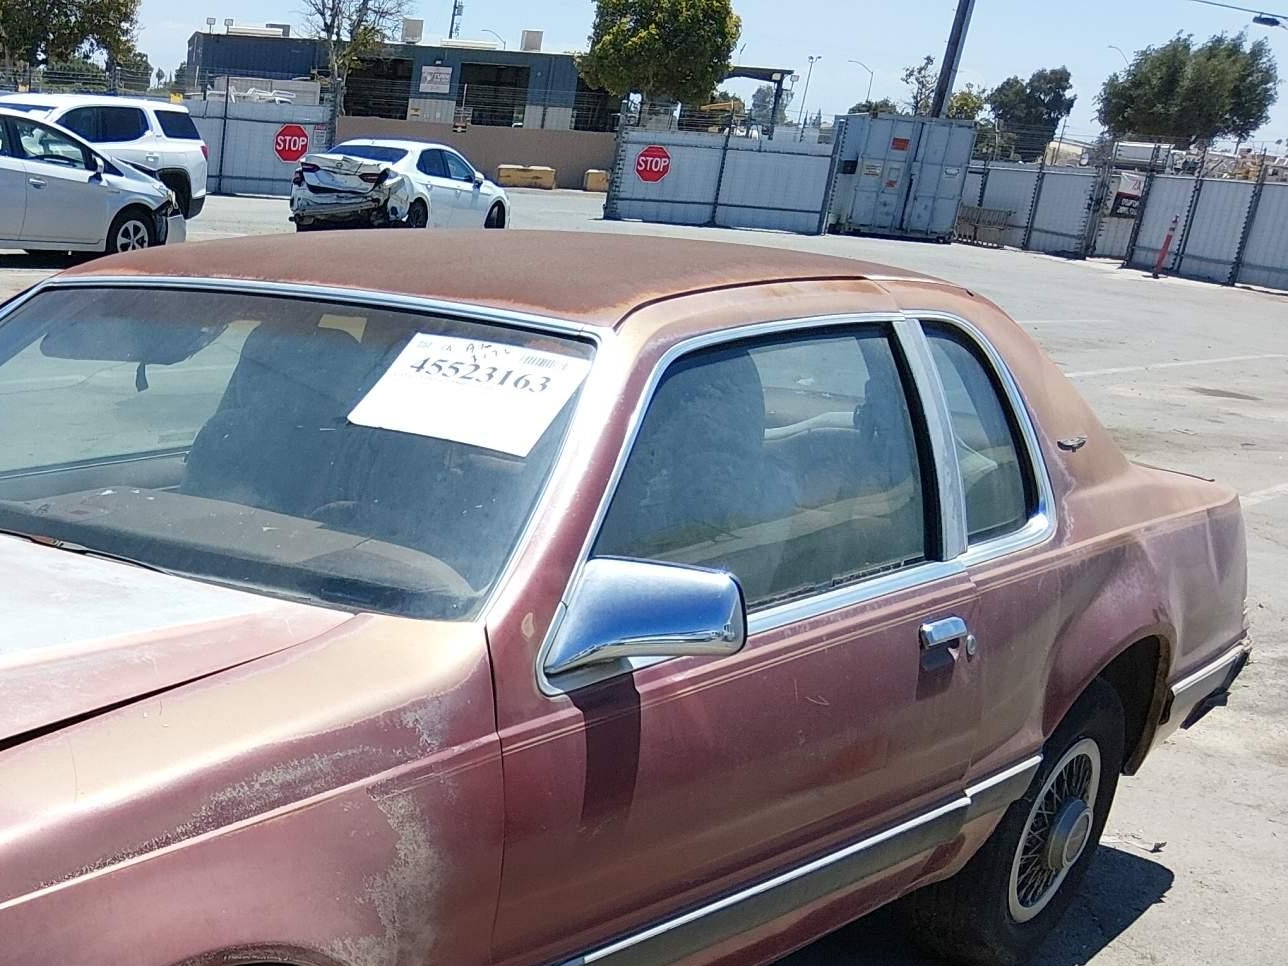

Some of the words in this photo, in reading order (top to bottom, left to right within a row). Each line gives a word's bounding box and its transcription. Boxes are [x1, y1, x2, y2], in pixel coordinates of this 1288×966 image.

[276, 136, 308, 151] STOP
[637, 156, 669, 172] STOP
[410, 357, 552, 393] 45523163
